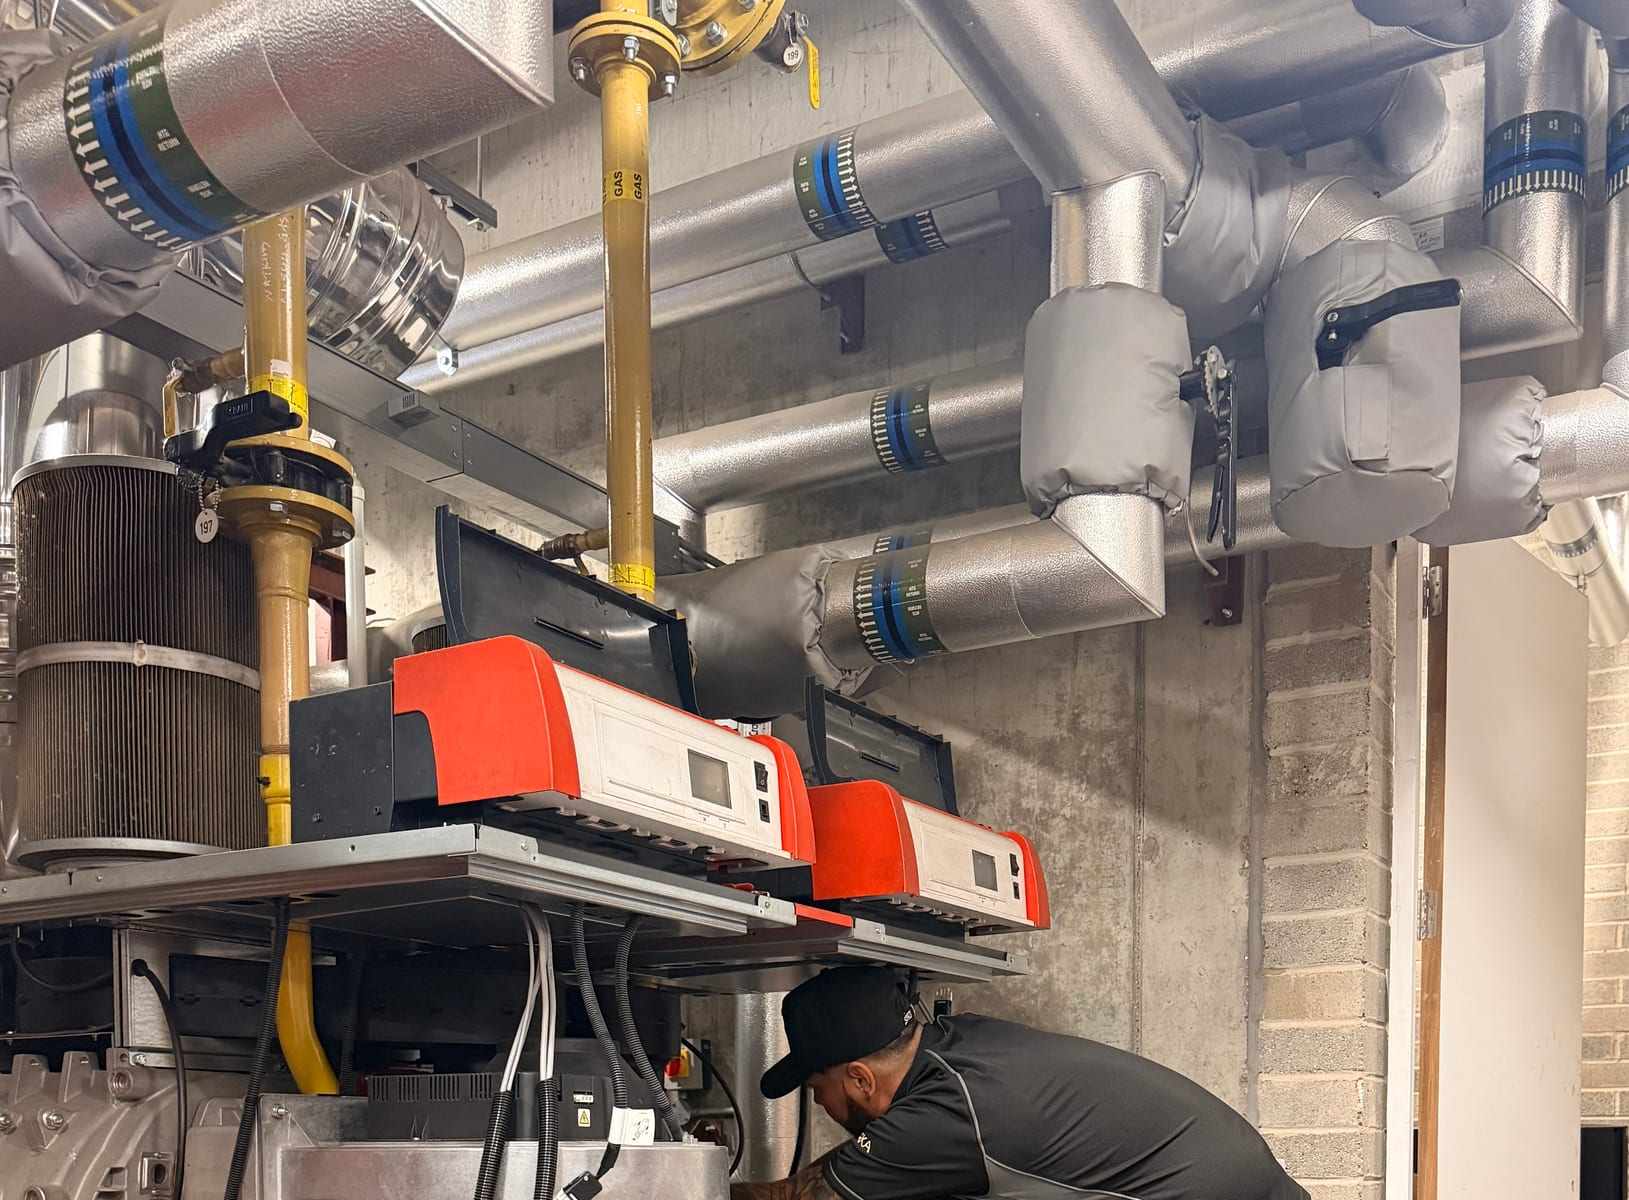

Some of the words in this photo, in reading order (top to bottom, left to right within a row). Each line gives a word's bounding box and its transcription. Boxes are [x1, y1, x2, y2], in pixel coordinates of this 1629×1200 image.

[787, 50, 799, 61] 199
[614, 171, 623, 197] GAS
[634, 173, 642, 199] GAS
[199, 520, 213, 535] 197
